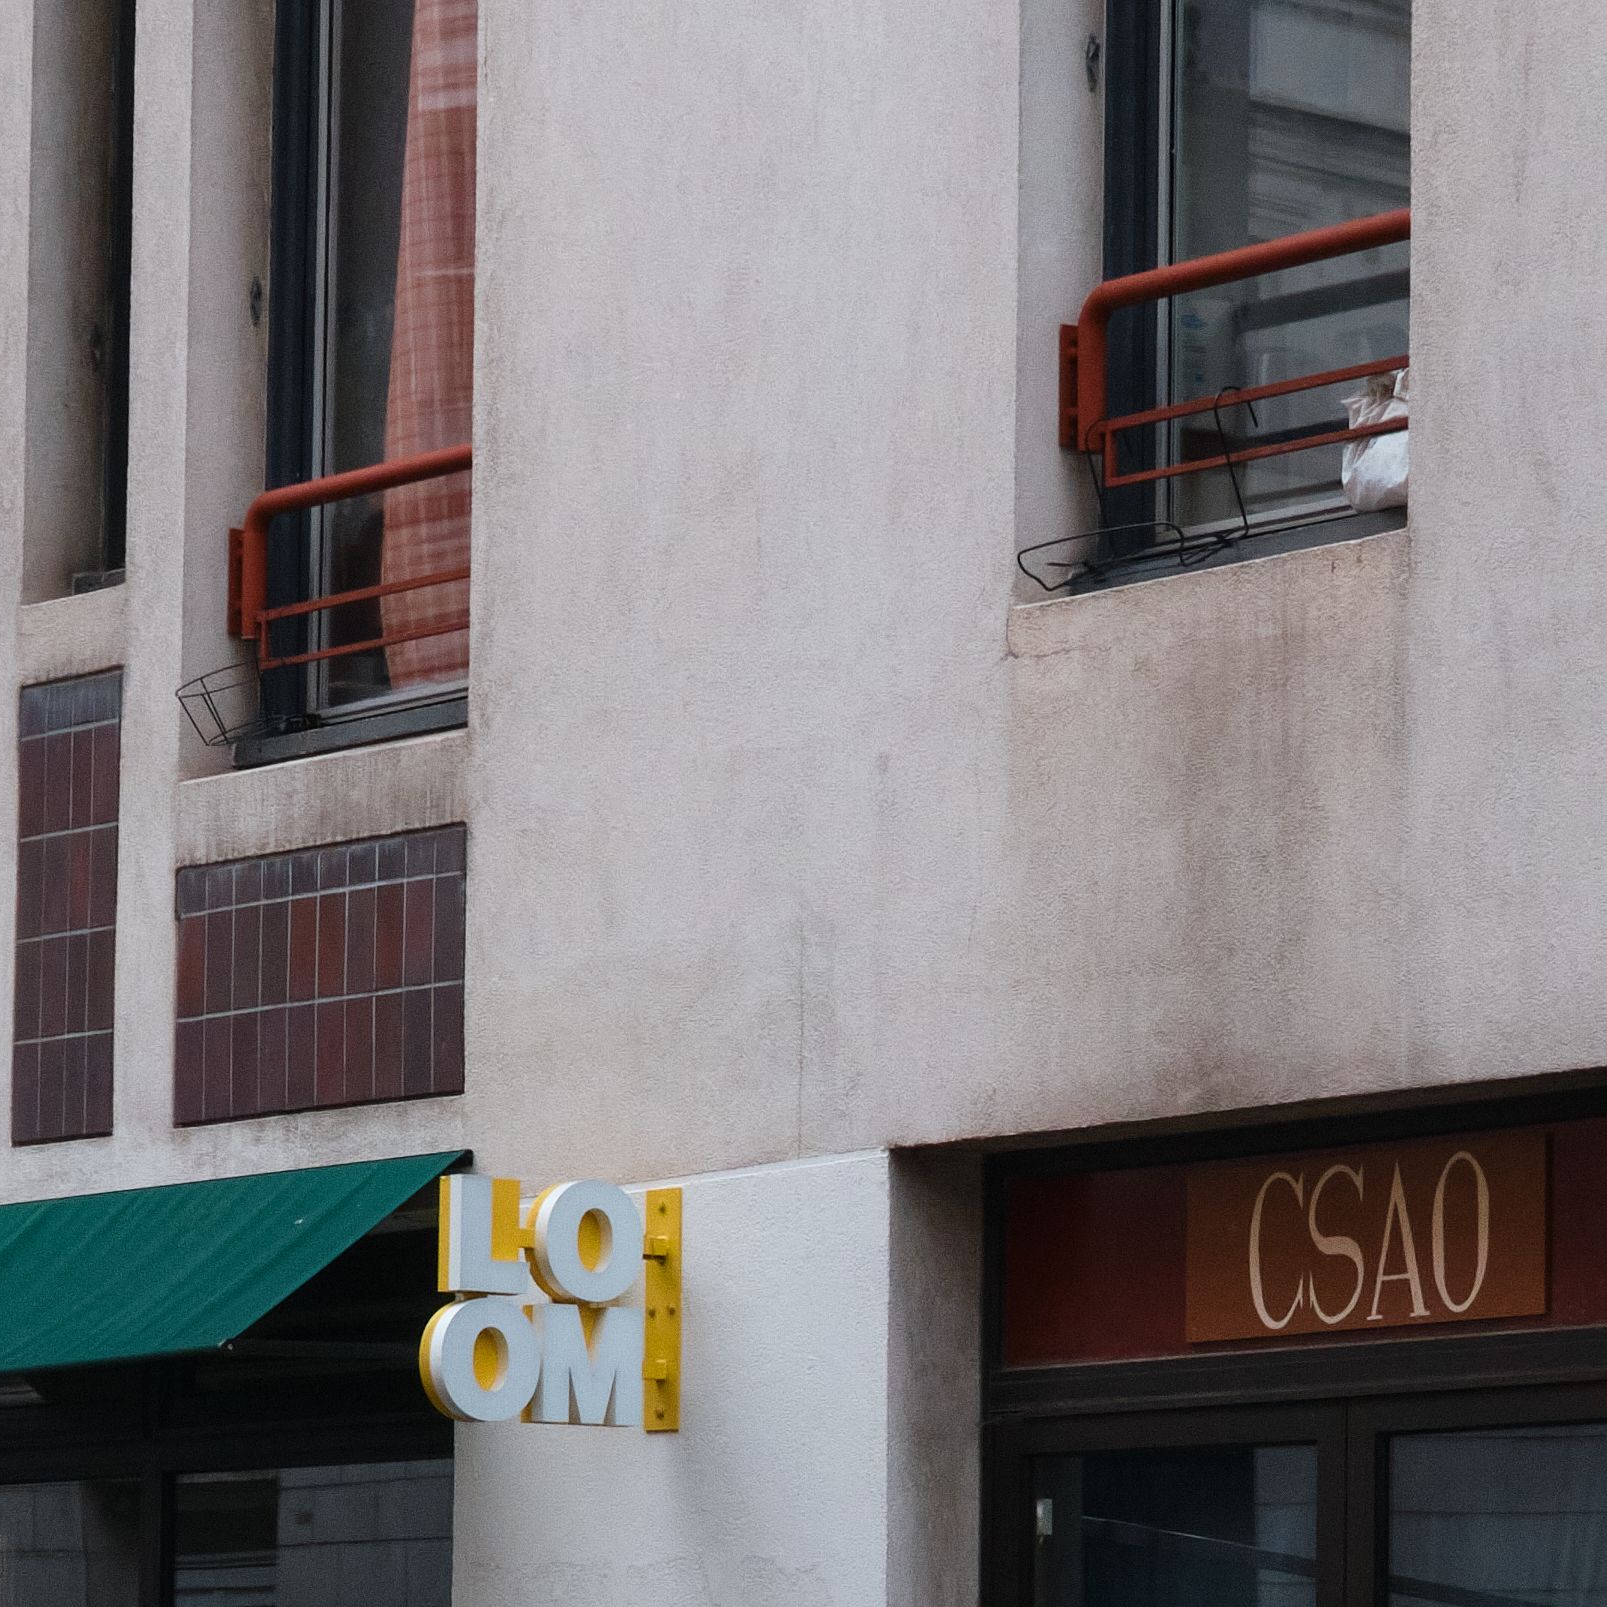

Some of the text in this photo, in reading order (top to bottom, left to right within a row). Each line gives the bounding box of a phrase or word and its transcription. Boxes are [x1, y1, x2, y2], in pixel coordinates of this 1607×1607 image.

[439, 1174, 642, 1302] LO
[1248, 1150, 1490, 1330] CSAO
[419, 1298, 642, 1426] OM
